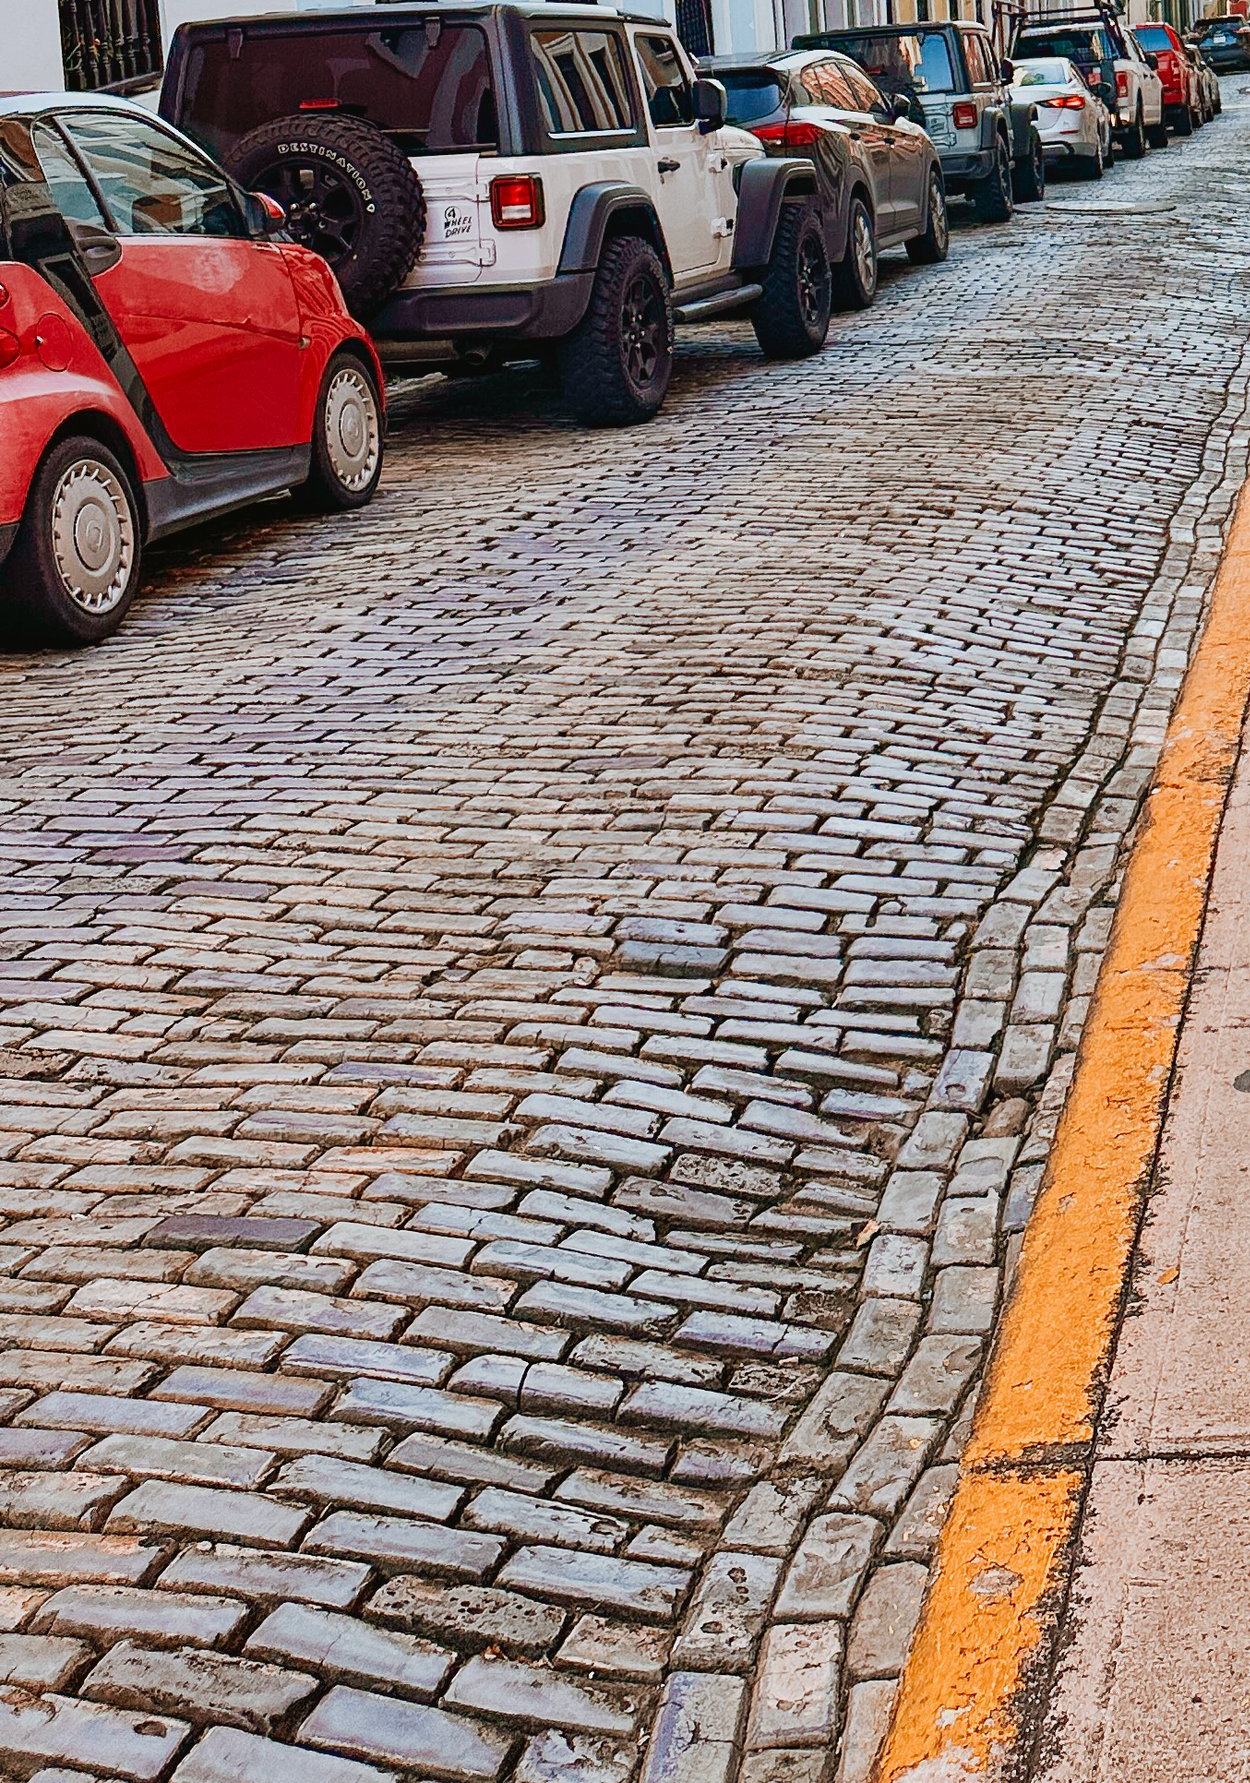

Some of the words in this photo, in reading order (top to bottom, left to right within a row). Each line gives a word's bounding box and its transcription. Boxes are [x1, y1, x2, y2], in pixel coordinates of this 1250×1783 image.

[277, 142, 372, 201] DESTINATION
[444, 216, 472, 229] WHEEL
[445, 225, 471, 238] DRIVE
